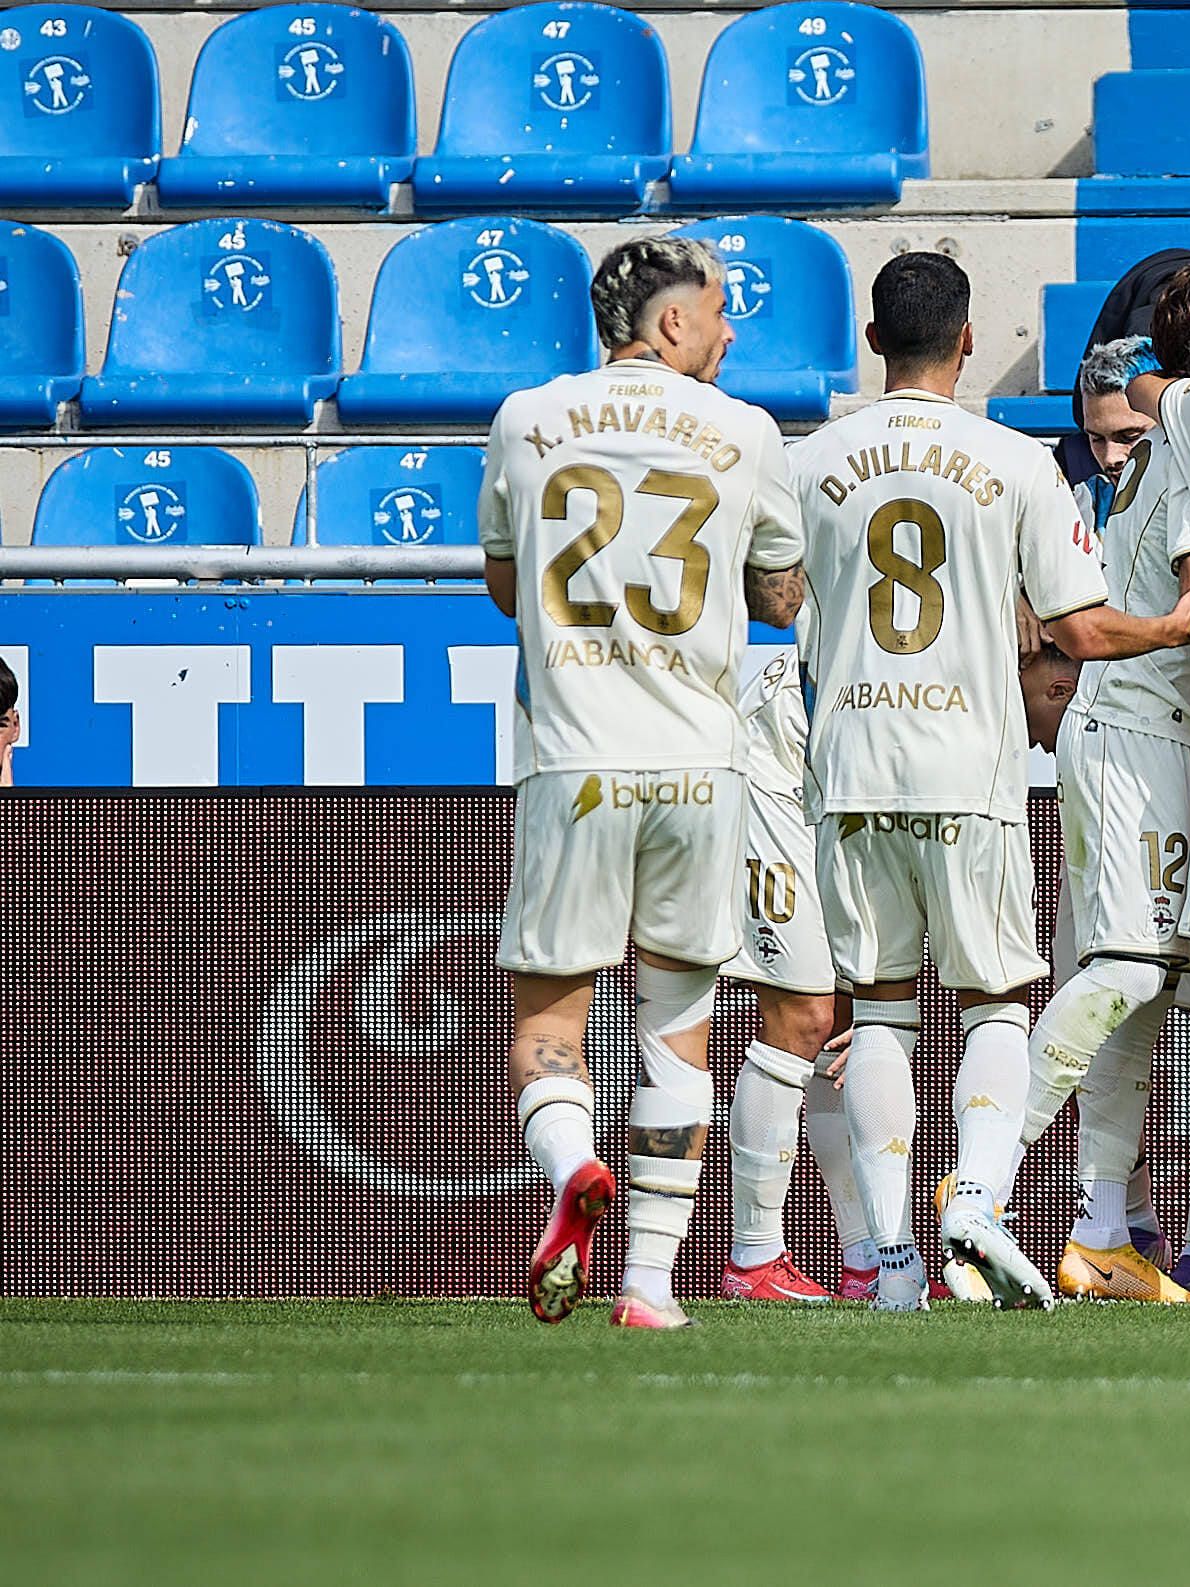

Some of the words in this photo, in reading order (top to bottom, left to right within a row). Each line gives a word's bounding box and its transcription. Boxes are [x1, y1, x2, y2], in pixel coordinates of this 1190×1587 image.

[40, 19, 67, 36] 43
[288, 18, 316, 35] 45
[543, 21, 571, 38] 47
[799, 18, 826, 35] 49
[218, 233, 246, 250] 45
[476, 230, 504, 246] 47
[718, 235, 746, 252] 49
[888, 415, 942, 429] FEIRACO
[144, 451, 171, 468] 45
[400, 452, 428, 469] 47
[541, 463, 720, 636] 23
[867, 498, 946, 655] 8
[1140, 831, 1188, 895] 12
[745, 859, 796, 924] 10
